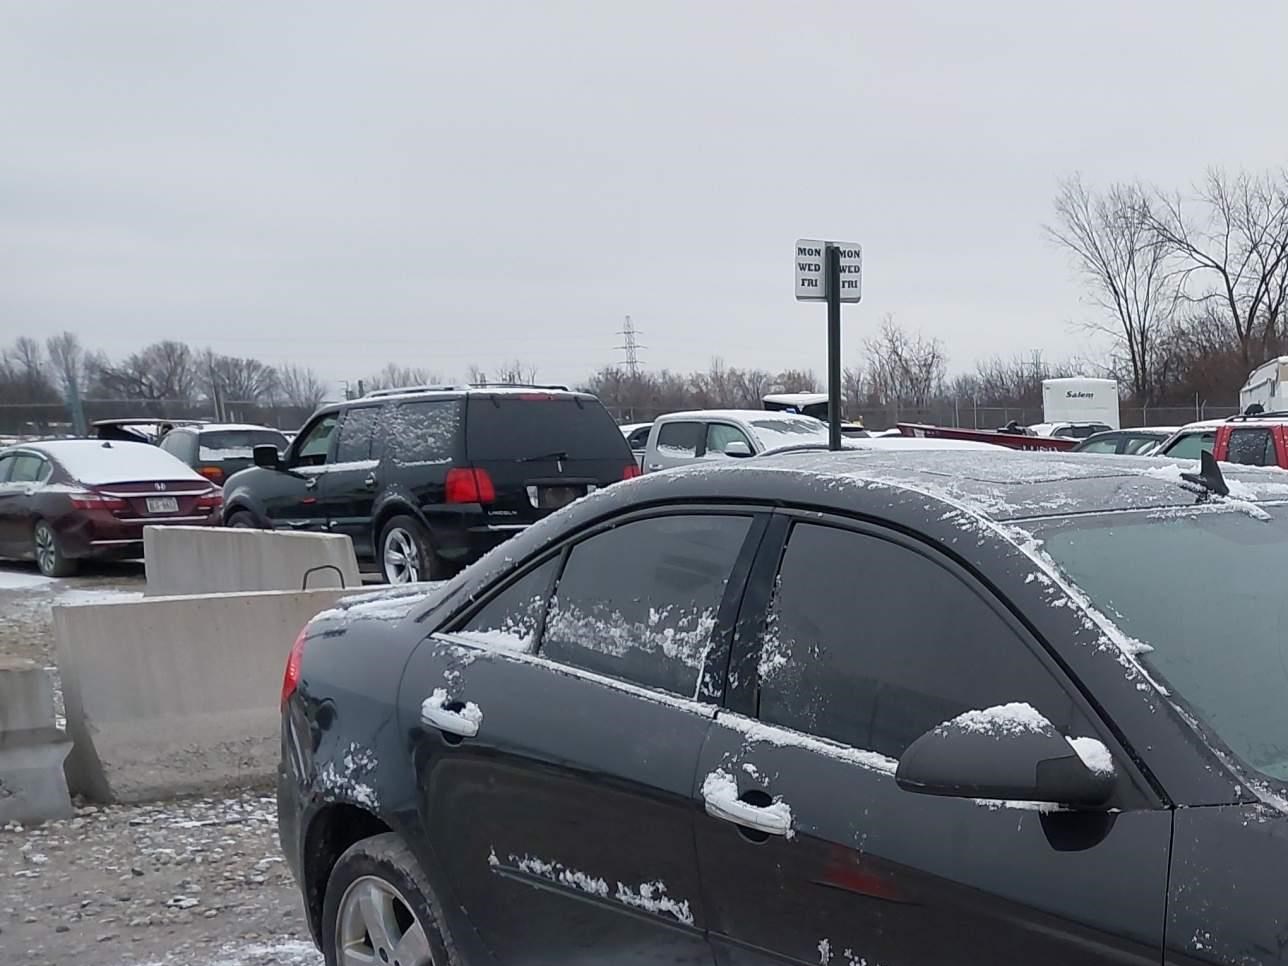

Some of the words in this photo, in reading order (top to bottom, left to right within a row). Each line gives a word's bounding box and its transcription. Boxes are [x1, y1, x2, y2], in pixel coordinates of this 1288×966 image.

[797, 247, 821, 257] MON
[840, 249, 860, 258] MON
[798, 262, 821, 272] WED
[840, 265, 860, 274] WED
[801, 278, 818, 287] FRI
[841, 279, 858, 288] FRI
[1065, 390, 1094, 398] Salem
